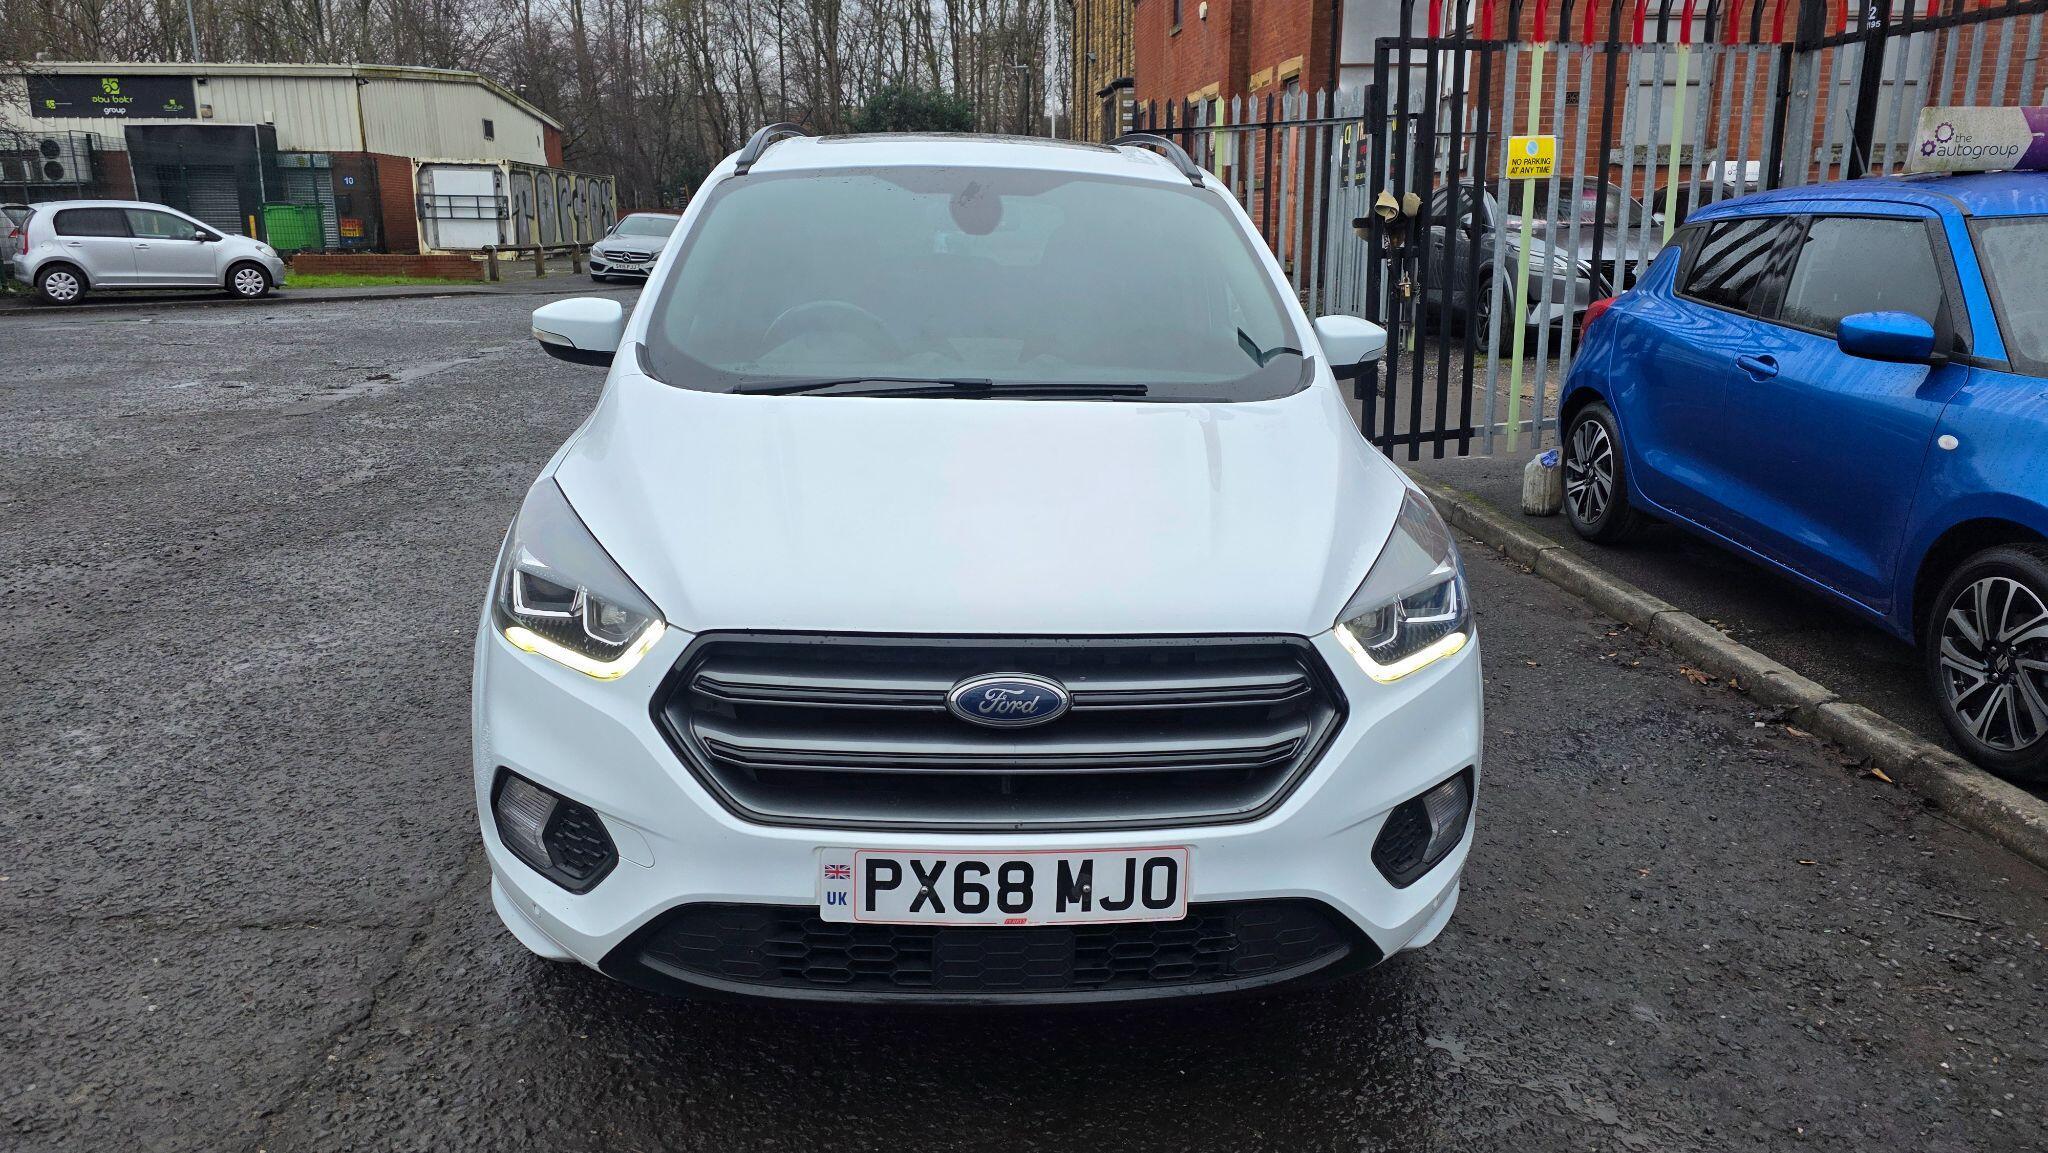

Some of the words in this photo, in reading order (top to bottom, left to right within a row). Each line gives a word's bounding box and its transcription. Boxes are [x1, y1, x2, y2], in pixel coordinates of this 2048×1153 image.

[103, 107, 127, 115] group
[1955, 133, 1973, 143] the
[1936, 143, 2019, 160] autogroup
[1536, 165, 1550, 173] TIME
[344, 176, 354, 185] 10
[978, 688, 1041, 716] Ford
[865, 858, 1035, 914] PX68
[1055, 856, 1178, 913] MJO
[826, 891, 848, 906] UK
